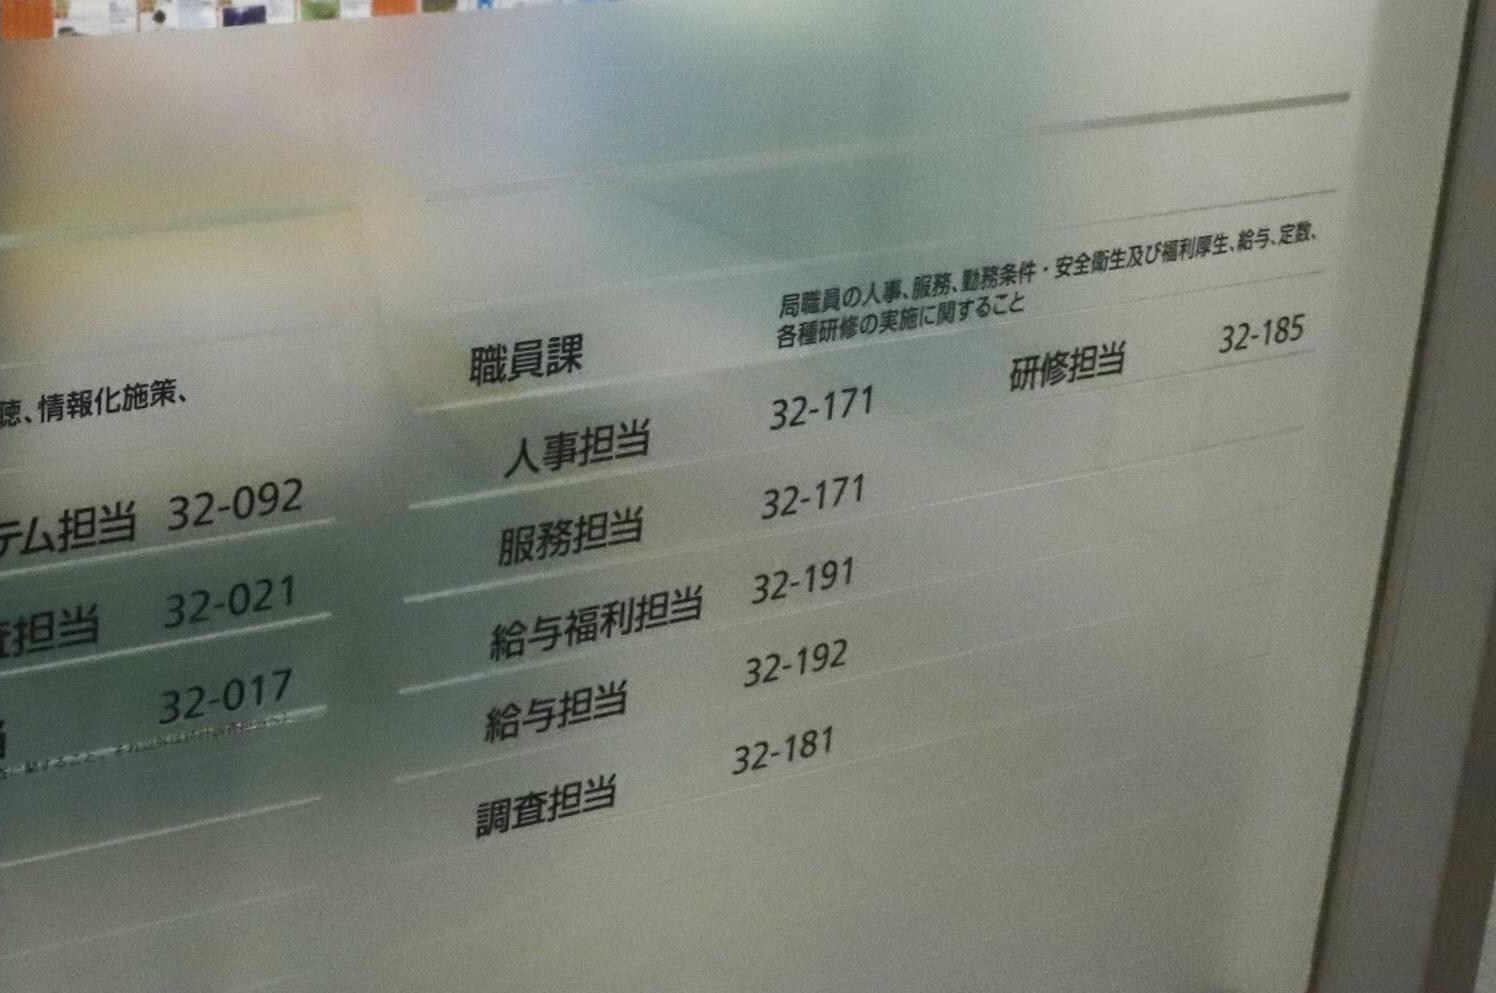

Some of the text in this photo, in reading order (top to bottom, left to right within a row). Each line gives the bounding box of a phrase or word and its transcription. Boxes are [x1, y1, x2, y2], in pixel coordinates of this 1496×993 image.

[777, 291, 1025, 350] 各種研修の実施に関すること
[1218, 313, 1306, 353] 32-185
[469, 333, 585, 387] 職員課
[1009, 340, 1126, 392] 研修担当
[769, 385, 874, 431] 32-171
[504, 418, 651, 479] 人事担当
[168, 477, 303, 531] 32-092
[761, 474, 865, 520] 32-171
[498, 506, 644, 567] 服務担当
[164, 575, 296, 628] 32-021
[751, 556, 854, 605] 32-191
[489, 585, 703, 662] 給与福利担当
[743, 638, 848, 688] 32-192
[158, 668, 293, 725] 32-017
[484, 679, 628, 745] 給与担当
[732, 725, 834, 775] 32-181
[475, 773, 618, 840] 調査担当
